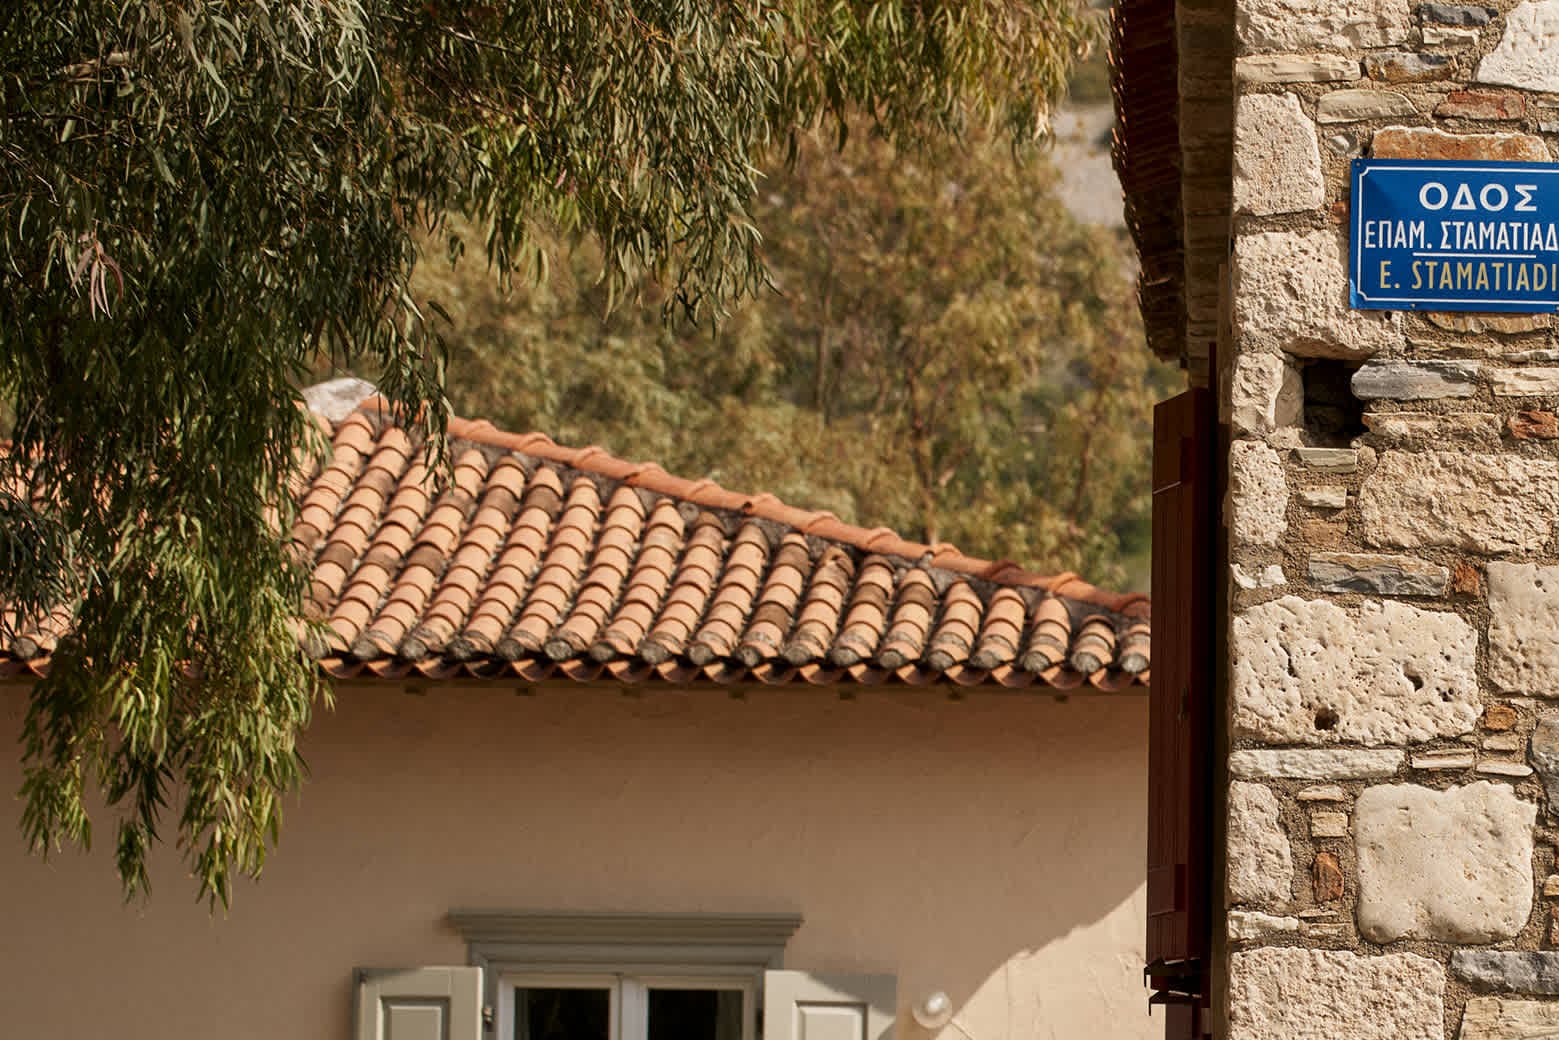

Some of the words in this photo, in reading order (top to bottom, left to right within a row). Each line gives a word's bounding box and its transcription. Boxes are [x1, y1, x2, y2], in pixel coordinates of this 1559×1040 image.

[1418, 182, 1538, 212] ΟΔΟΣ
[1364, 220, 1433, 249] ΕΠΑΜ.
[1379, 260, 1400, 290] E.
